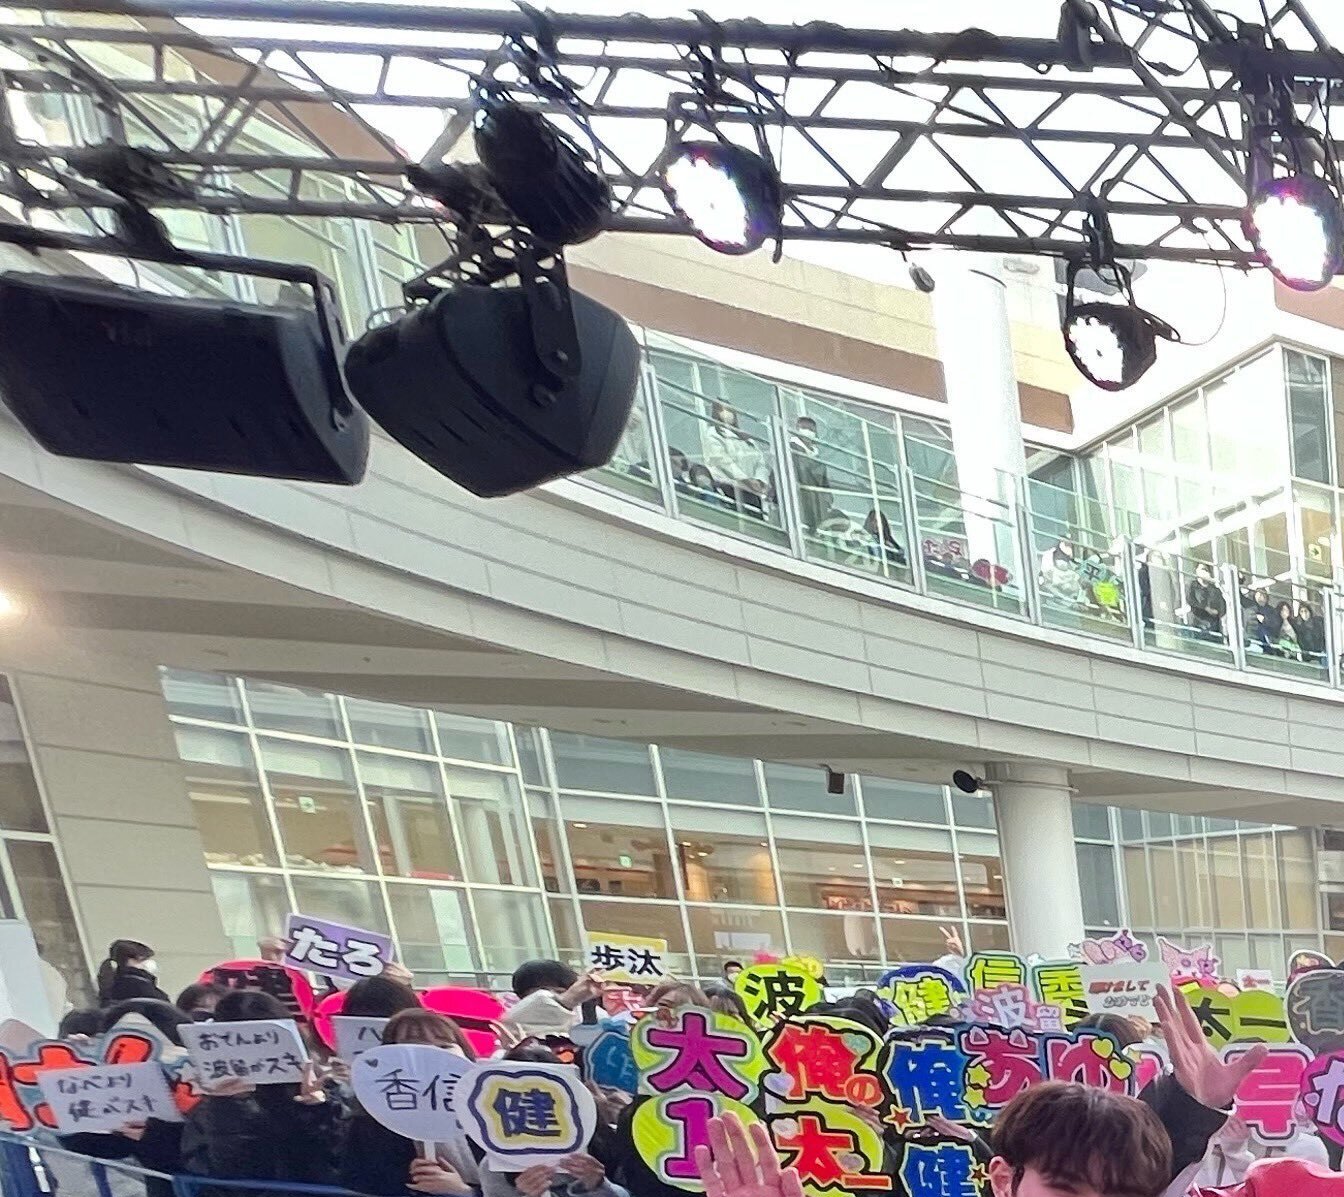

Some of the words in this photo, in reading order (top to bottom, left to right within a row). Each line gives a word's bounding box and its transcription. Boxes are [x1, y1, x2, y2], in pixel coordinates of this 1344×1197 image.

[292, 926, 386, 977] たろ
[591, 945, 664, 977] 歩汰
[492, 1088, 562, 1138] 健
